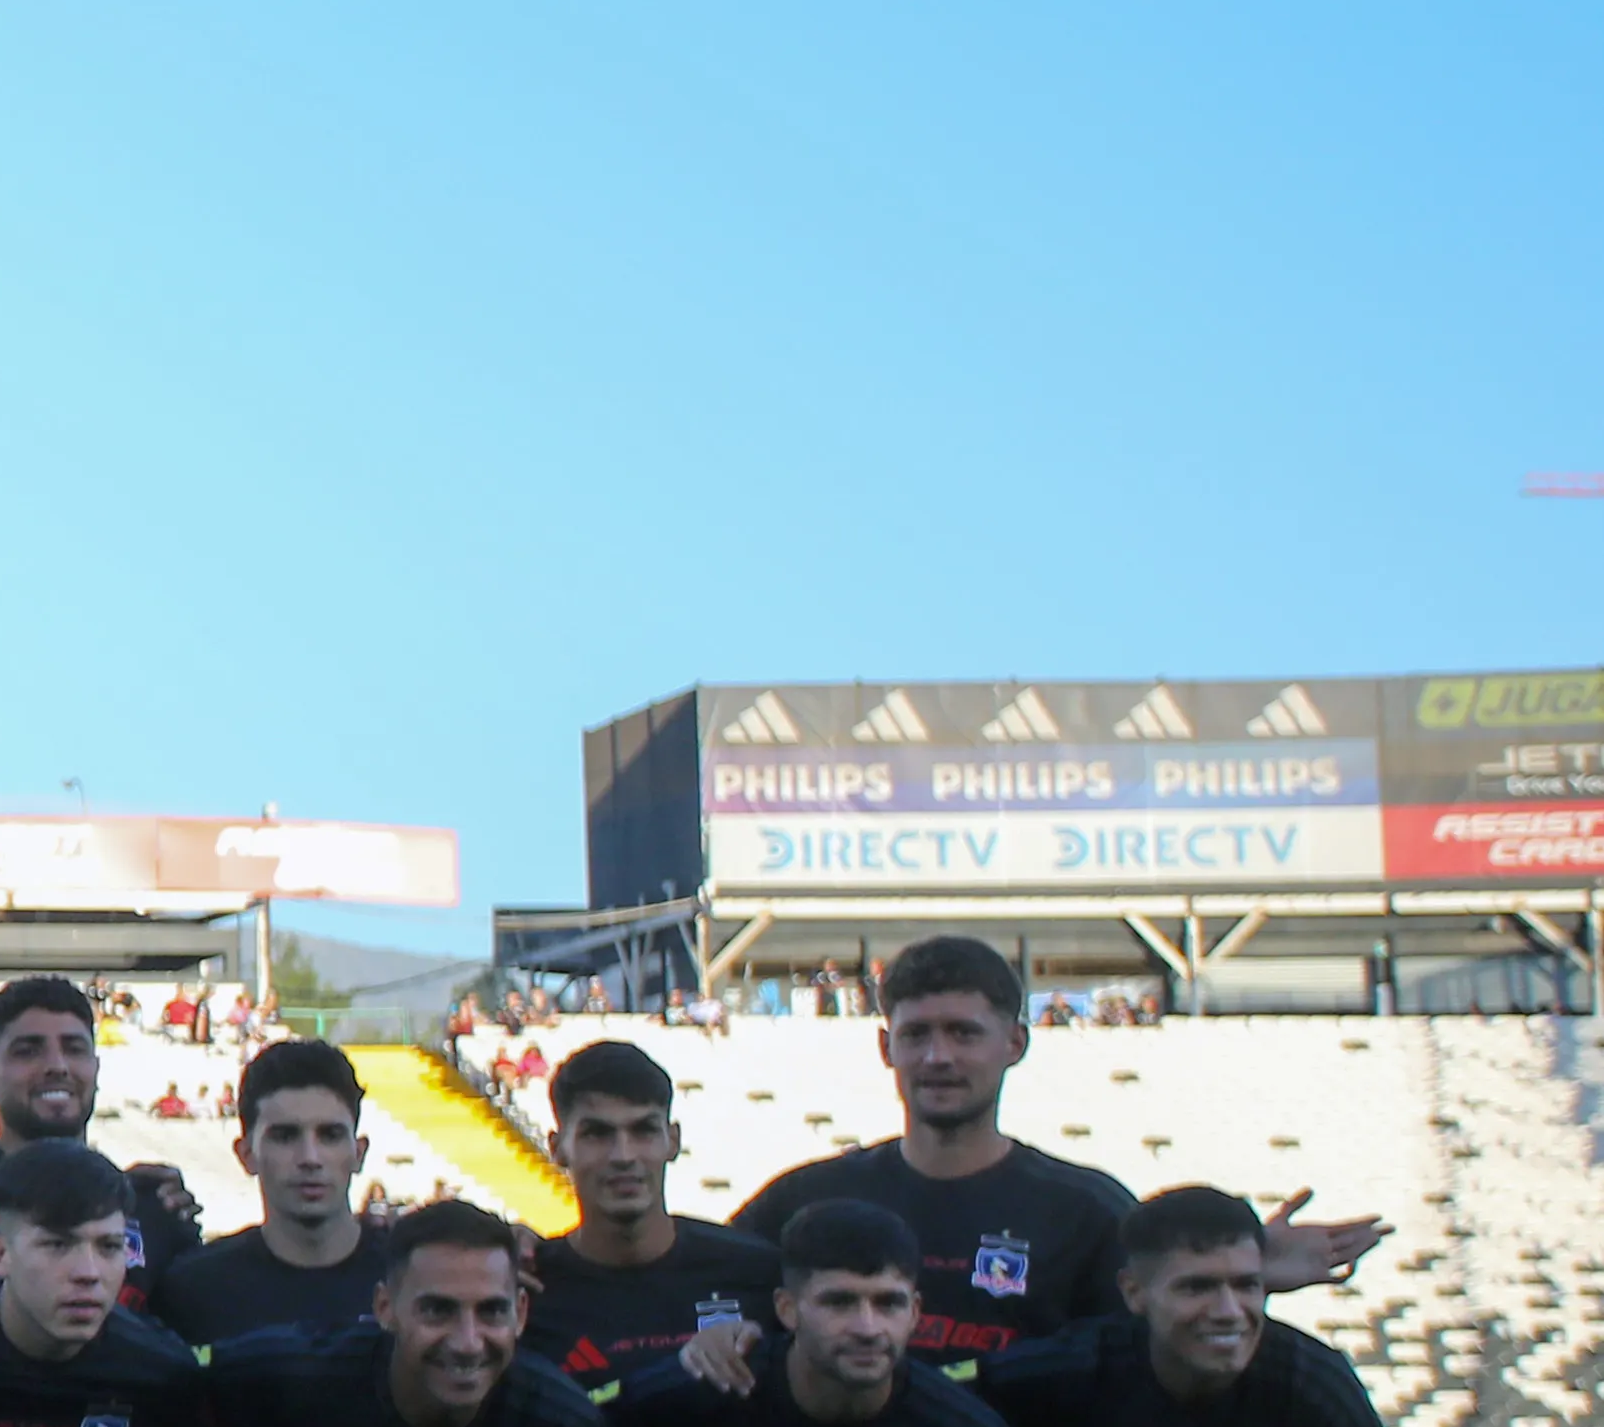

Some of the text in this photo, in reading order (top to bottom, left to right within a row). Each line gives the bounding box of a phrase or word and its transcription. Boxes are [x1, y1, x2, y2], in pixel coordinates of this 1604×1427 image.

[713, 756, 1341, 803] PHILIPS PHILIPS PHILIPS
[1478, 743, 1604, 775] JET
[758, 824, 1298, 872] DIRECTV DIRECTV
